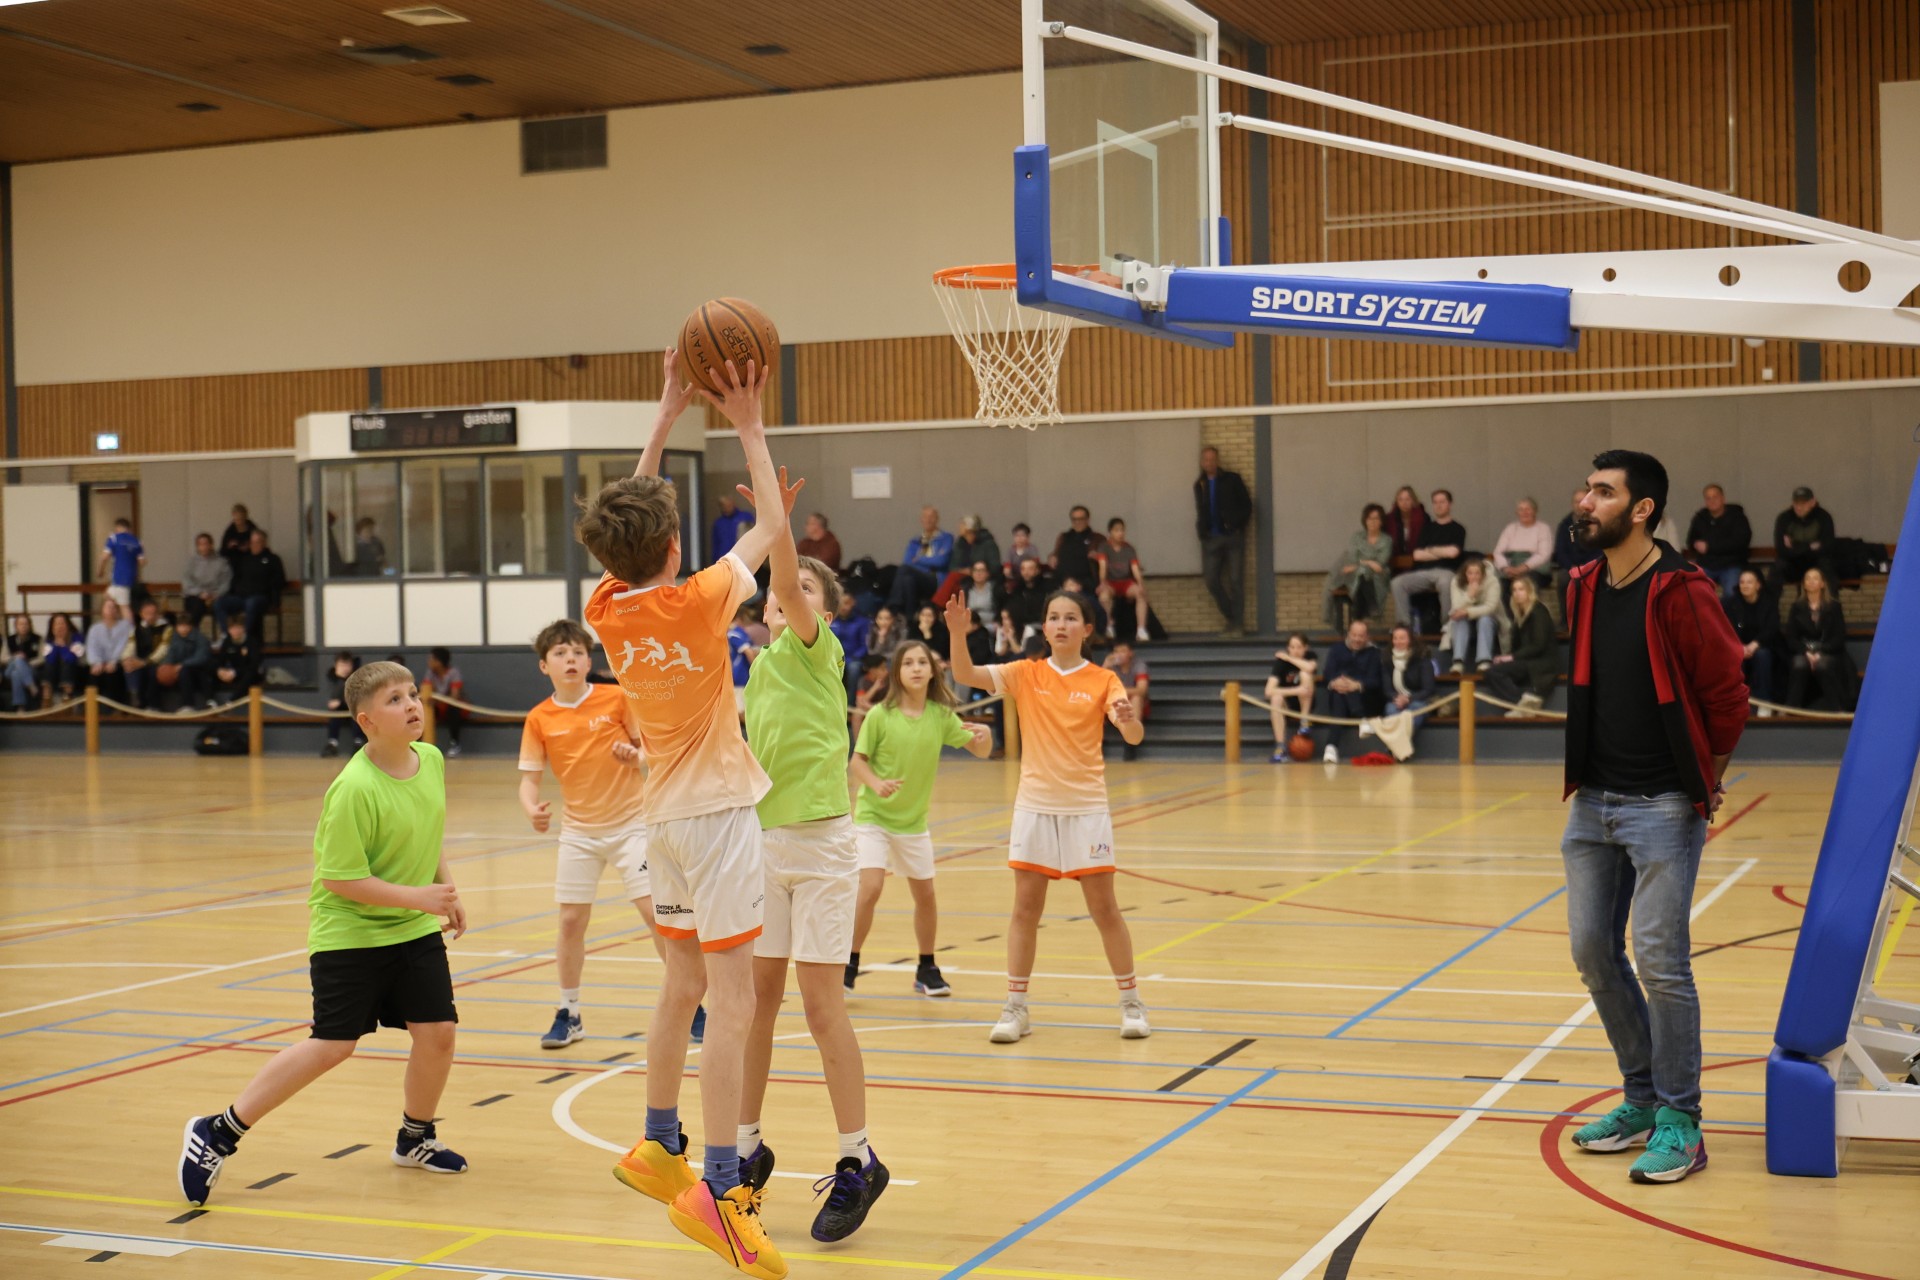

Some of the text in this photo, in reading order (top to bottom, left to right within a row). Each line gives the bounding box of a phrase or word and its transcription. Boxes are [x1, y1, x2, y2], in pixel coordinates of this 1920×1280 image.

[352, 410, 512, 431] thuis gasten
[623, 674, 686, 689] Brederode
